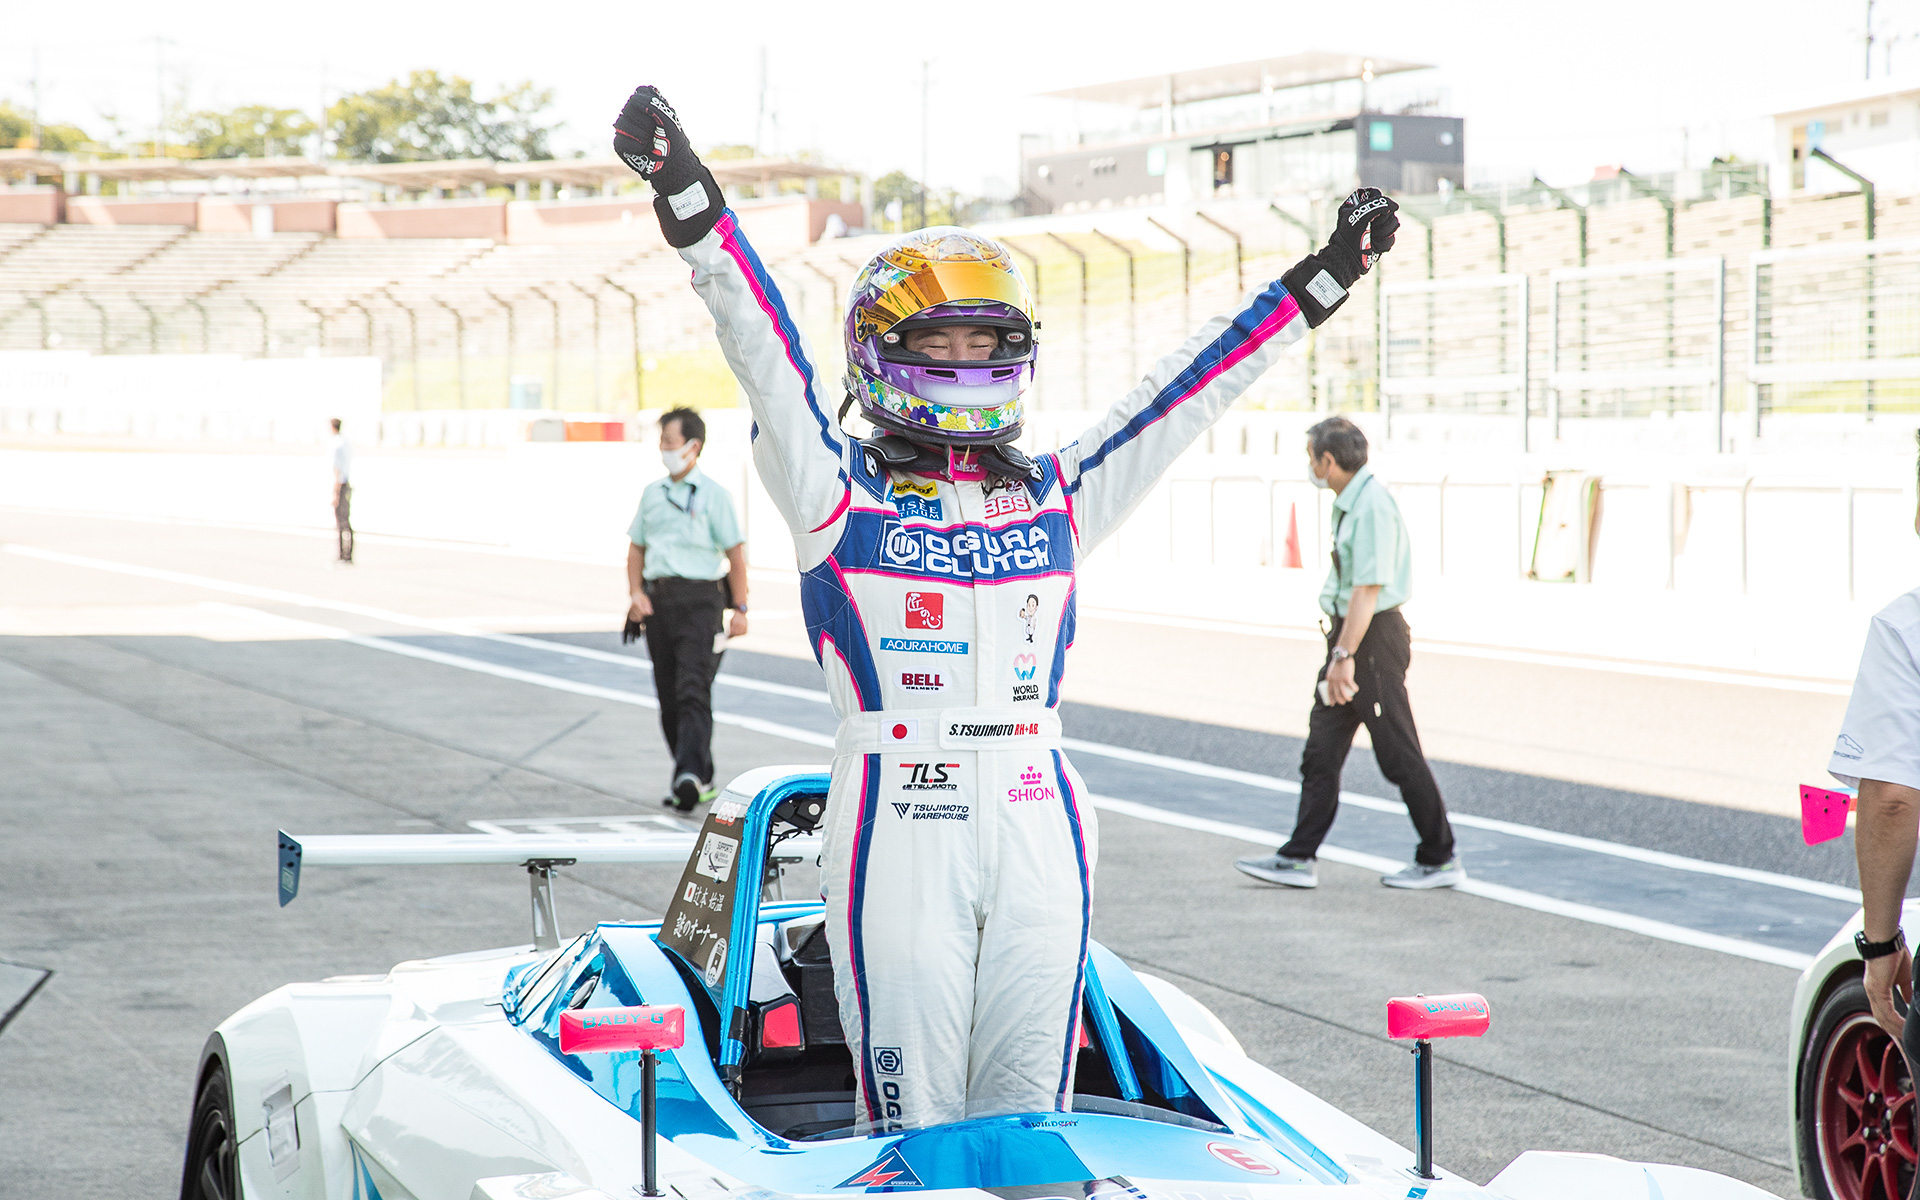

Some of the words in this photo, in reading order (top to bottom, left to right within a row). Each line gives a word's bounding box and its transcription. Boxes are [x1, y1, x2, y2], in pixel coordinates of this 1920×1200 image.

[1348, 197, 1388, 226] sparco
[893, 483, 934, 495] UNLOP
[984, 495, 1031, 519] BBS
[926, 525, 1049, 557] OGURA
[926, 544, 1050, 577] CLUTCH
[885, 639, 963, 653] AQURAHOME
[901, 672, 944, 687] BELL
[1012, 684, 1039, 696] WORLD
[1012, 693, 1040, 703] INSURANCE
[948, 723, 1014, 736] S.TSUJIMOTO
[1007, 786, 1055, 803] SHION
[914, 804, 969, 814] TSUJIMOTO
[912, 812, 970, 822] WAREHOUSE
[583, 1012, 664, 1030] BABY-G
